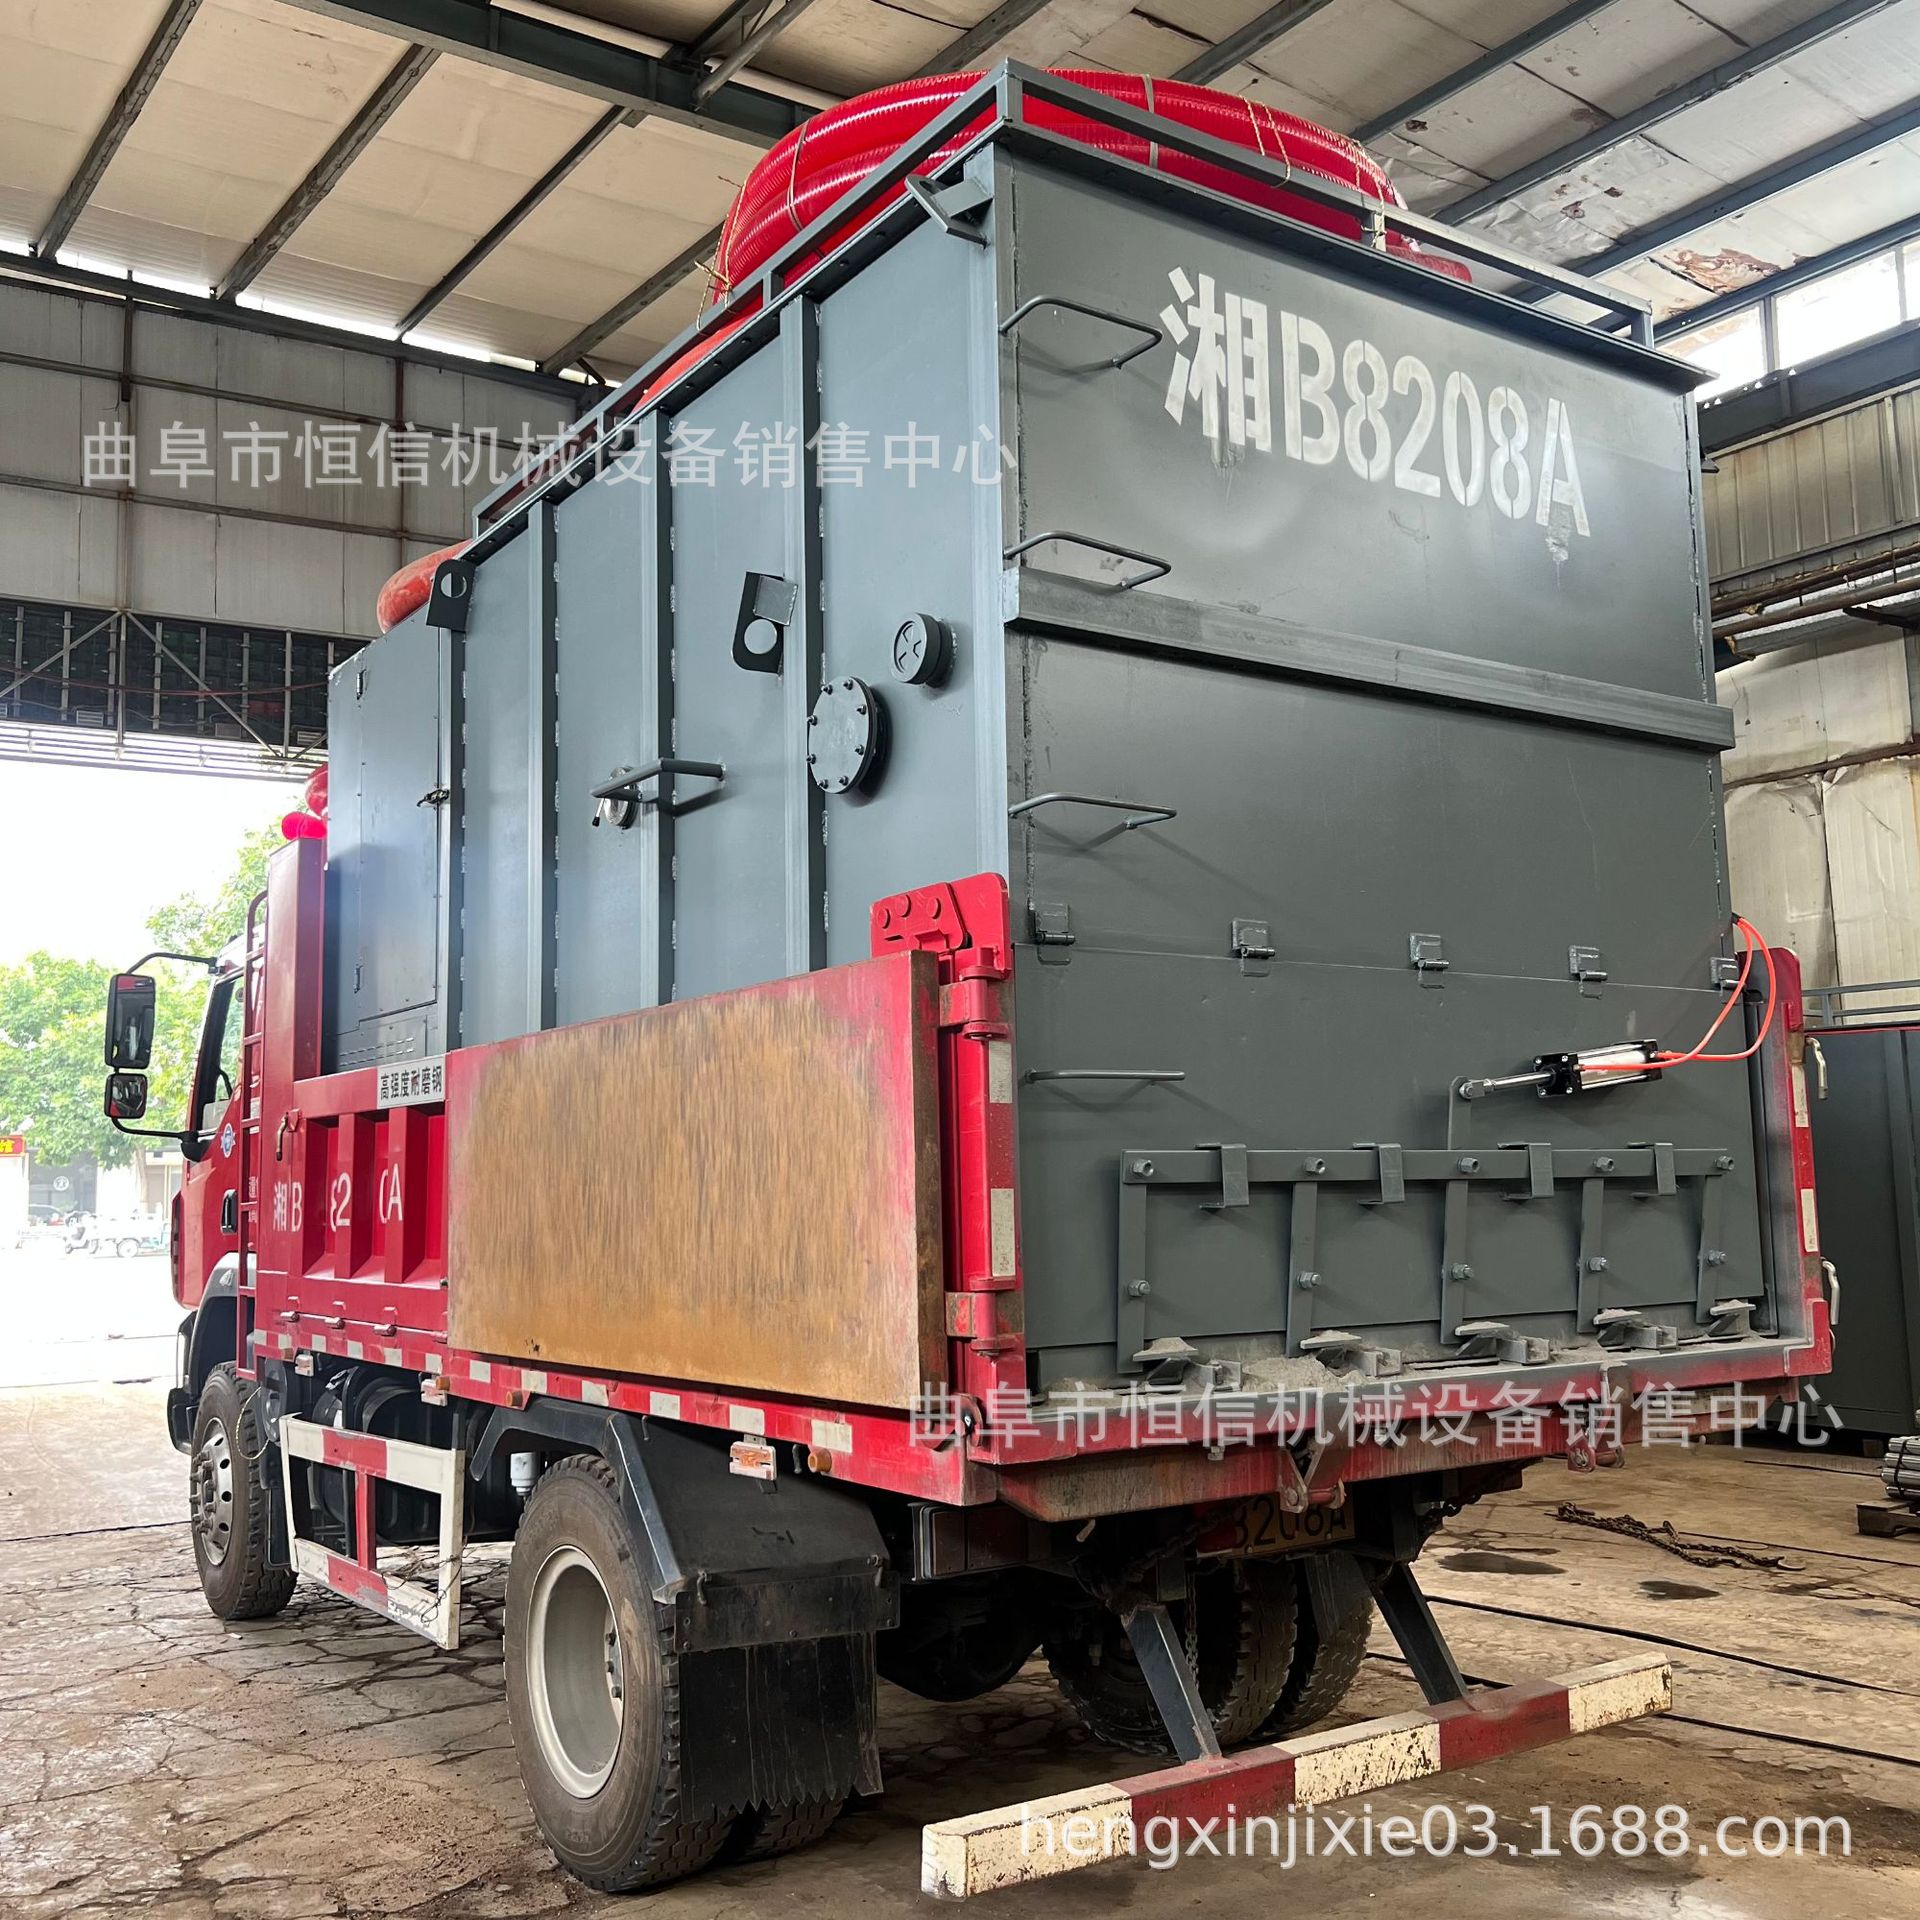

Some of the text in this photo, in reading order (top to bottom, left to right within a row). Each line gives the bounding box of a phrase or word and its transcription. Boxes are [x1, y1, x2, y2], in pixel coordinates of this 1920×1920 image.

[1159, 267, 1591, 537] 湘B8208A
[381, 1065, 442, 1100] 高强度耐磨钢
